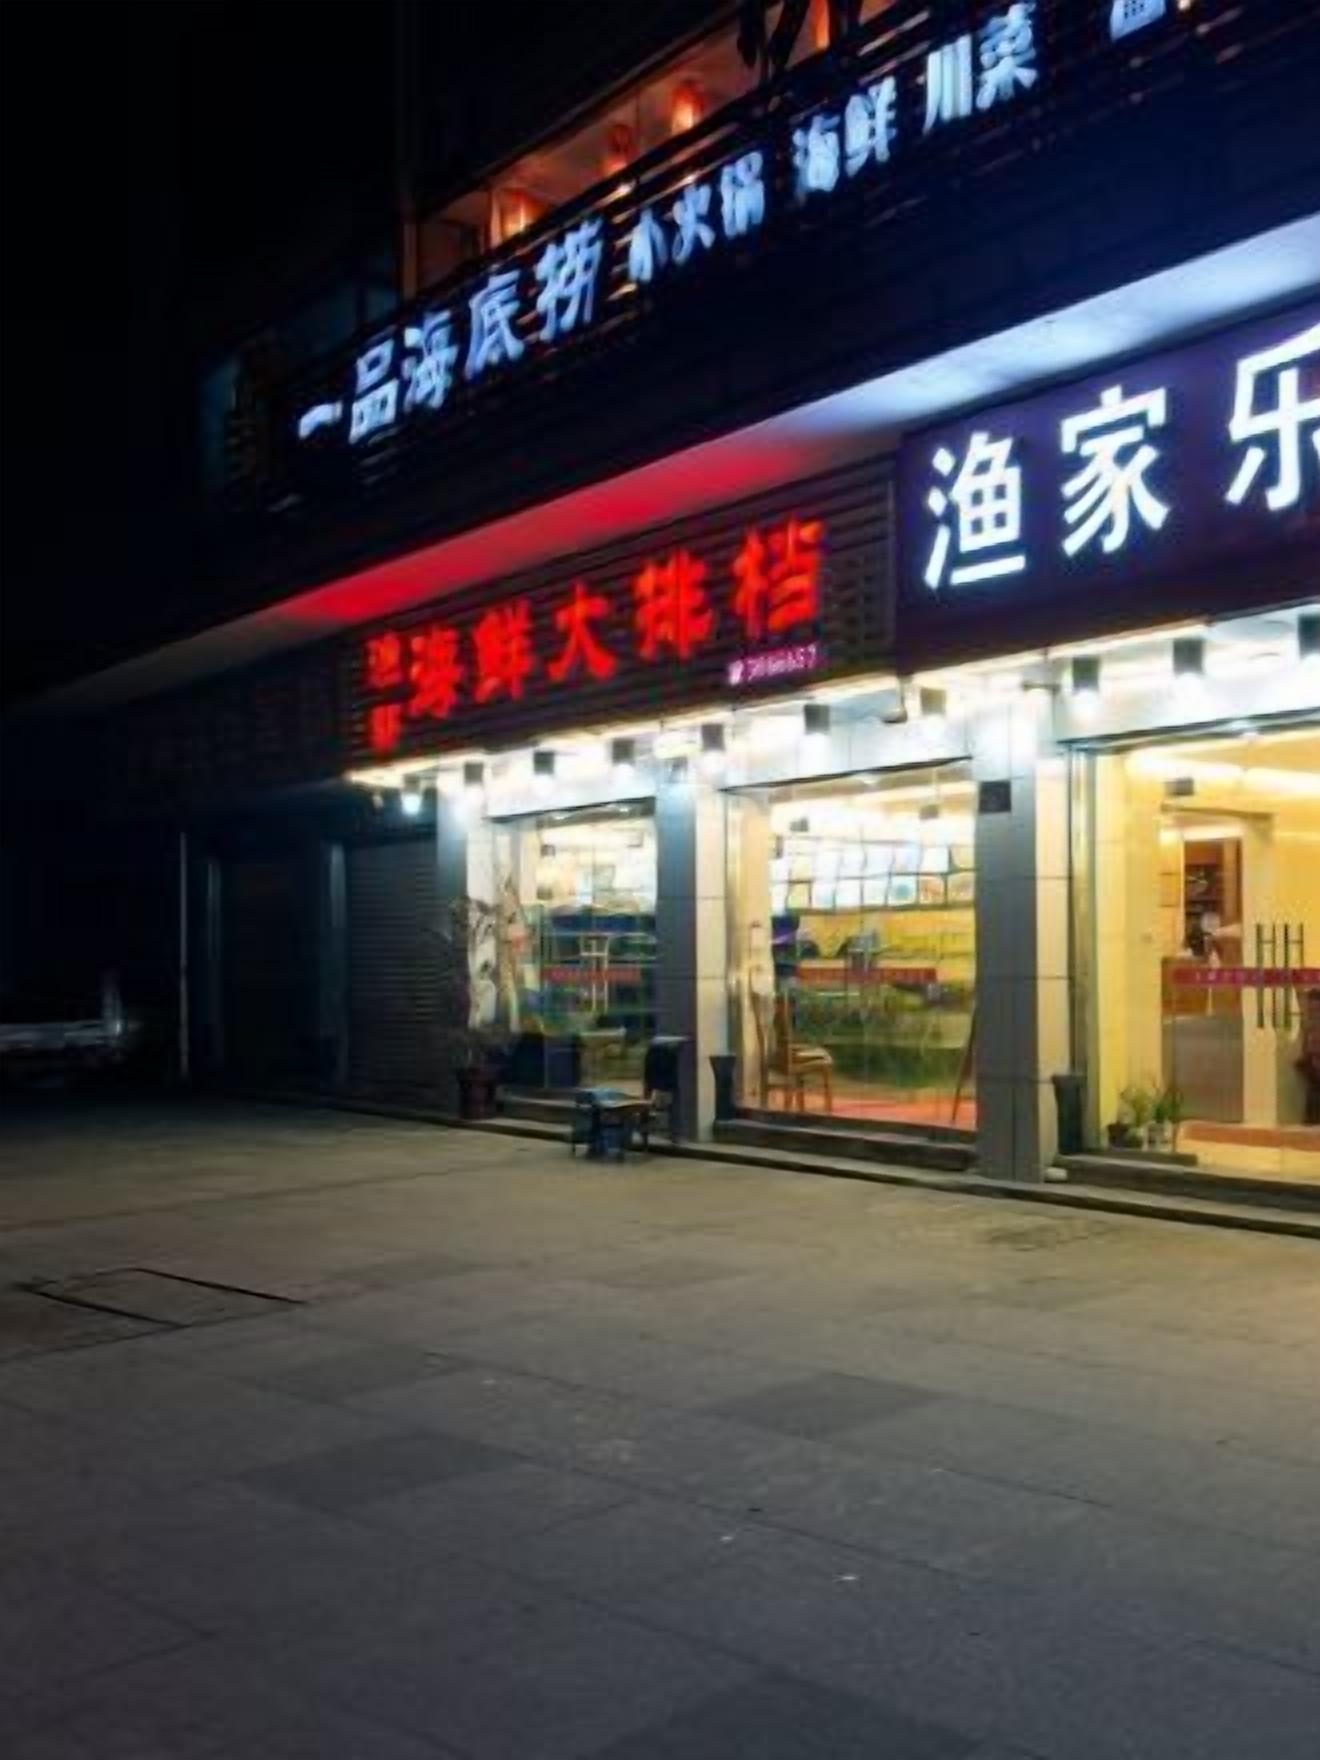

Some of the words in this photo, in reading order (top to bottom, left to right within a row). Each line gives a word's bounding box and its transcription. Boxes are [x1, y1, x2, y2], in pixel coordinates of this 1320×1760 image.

[922, 1, 1039, 134] 川菜
[408, 517, 825, 718] 海鲜大排档
